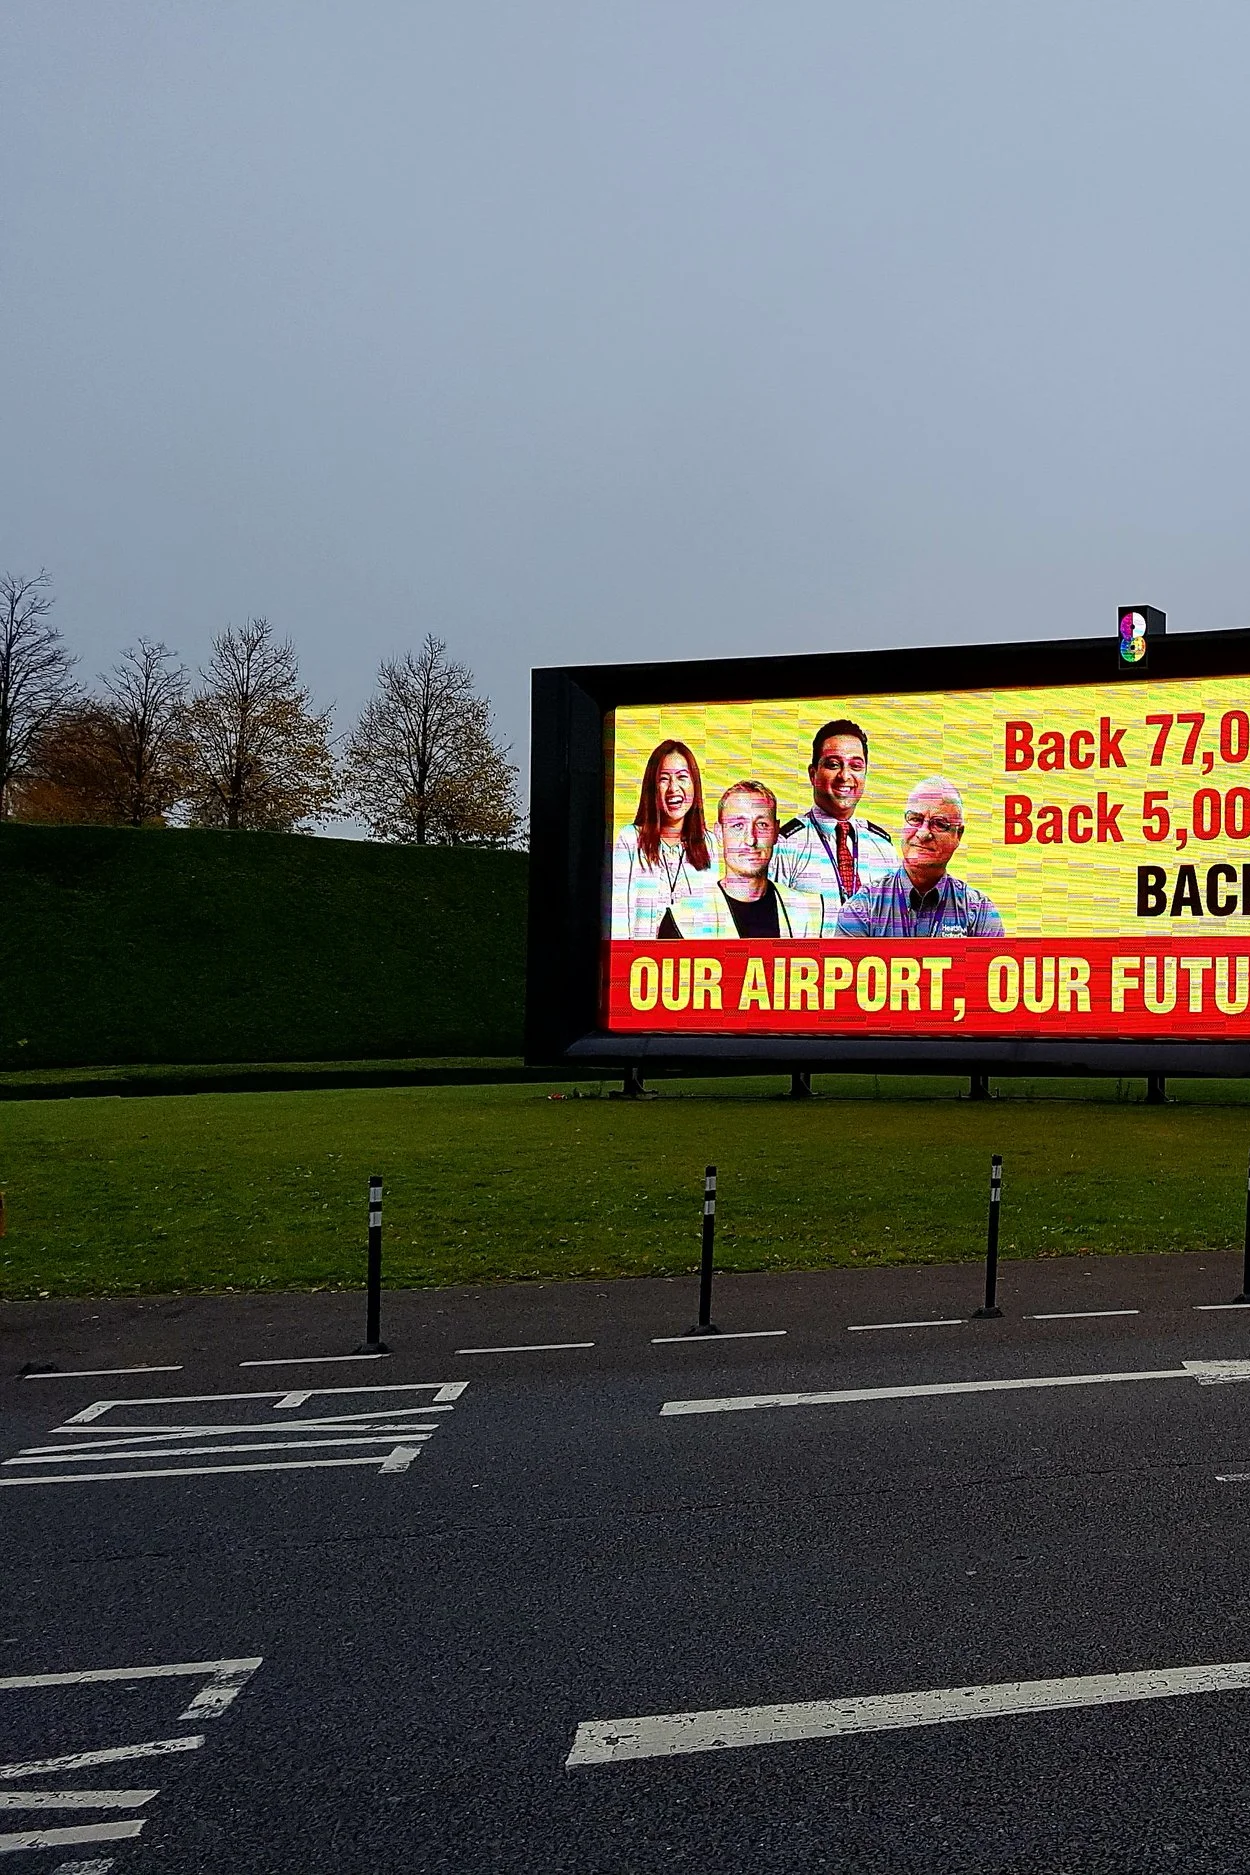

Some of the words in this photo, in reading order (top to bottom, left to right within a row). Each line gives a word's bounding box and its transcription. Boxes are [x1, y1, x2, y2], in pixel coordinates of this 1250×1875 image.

[1005, 717, 1126, 771] Back
[1005, 792, 1123, 844] Back
[630, 957, 722, 1010] OUR
[739, 956, 965, 1021] AIRPORT,
[988, 956, 1091, 1012] OUR
